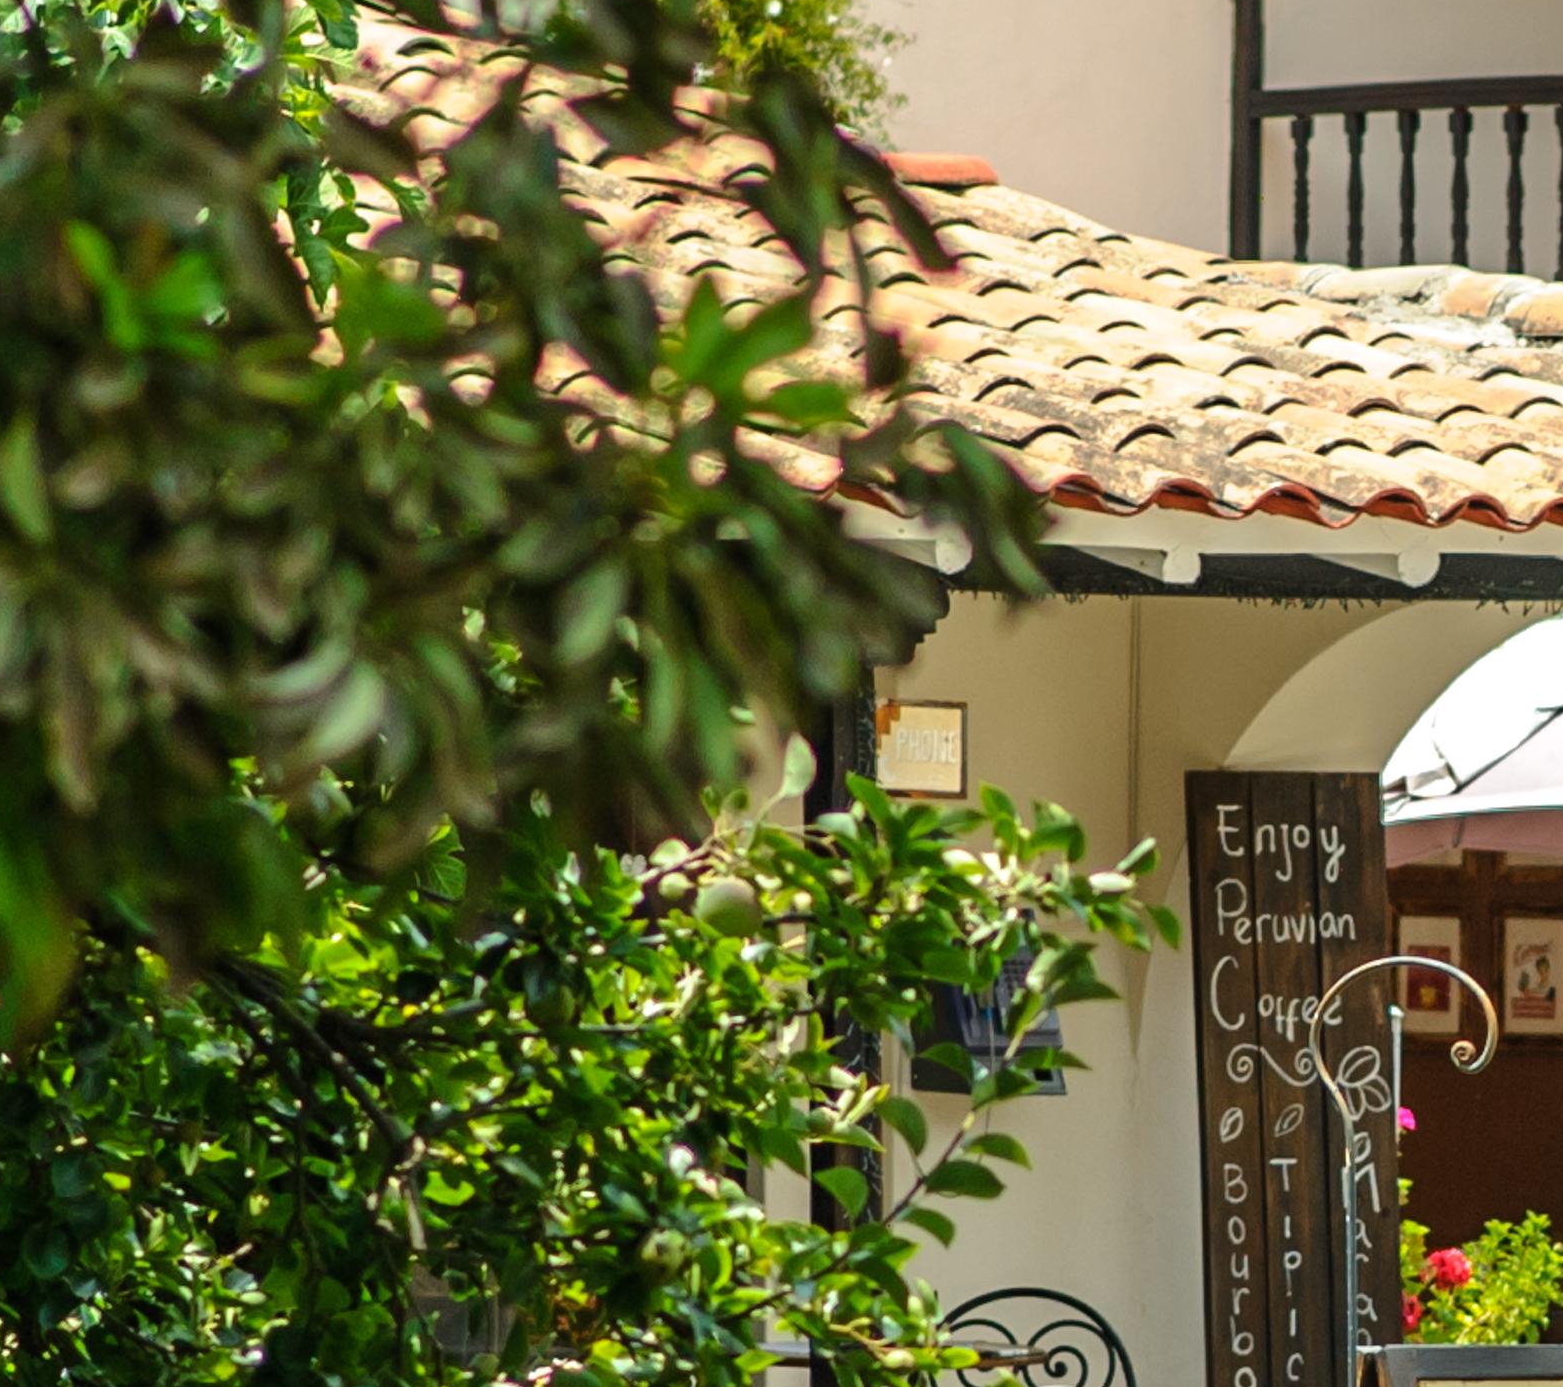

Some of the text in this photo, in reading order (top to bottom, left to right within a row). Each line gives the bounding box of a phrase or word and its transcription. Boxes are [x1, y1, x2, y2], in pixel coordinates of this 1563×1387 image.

[1216, 804, 1346, 883] Enjoy
[1215, 878, 1357, 946] Peruvian
[1210, 955, 1343, 1042] Coffee
